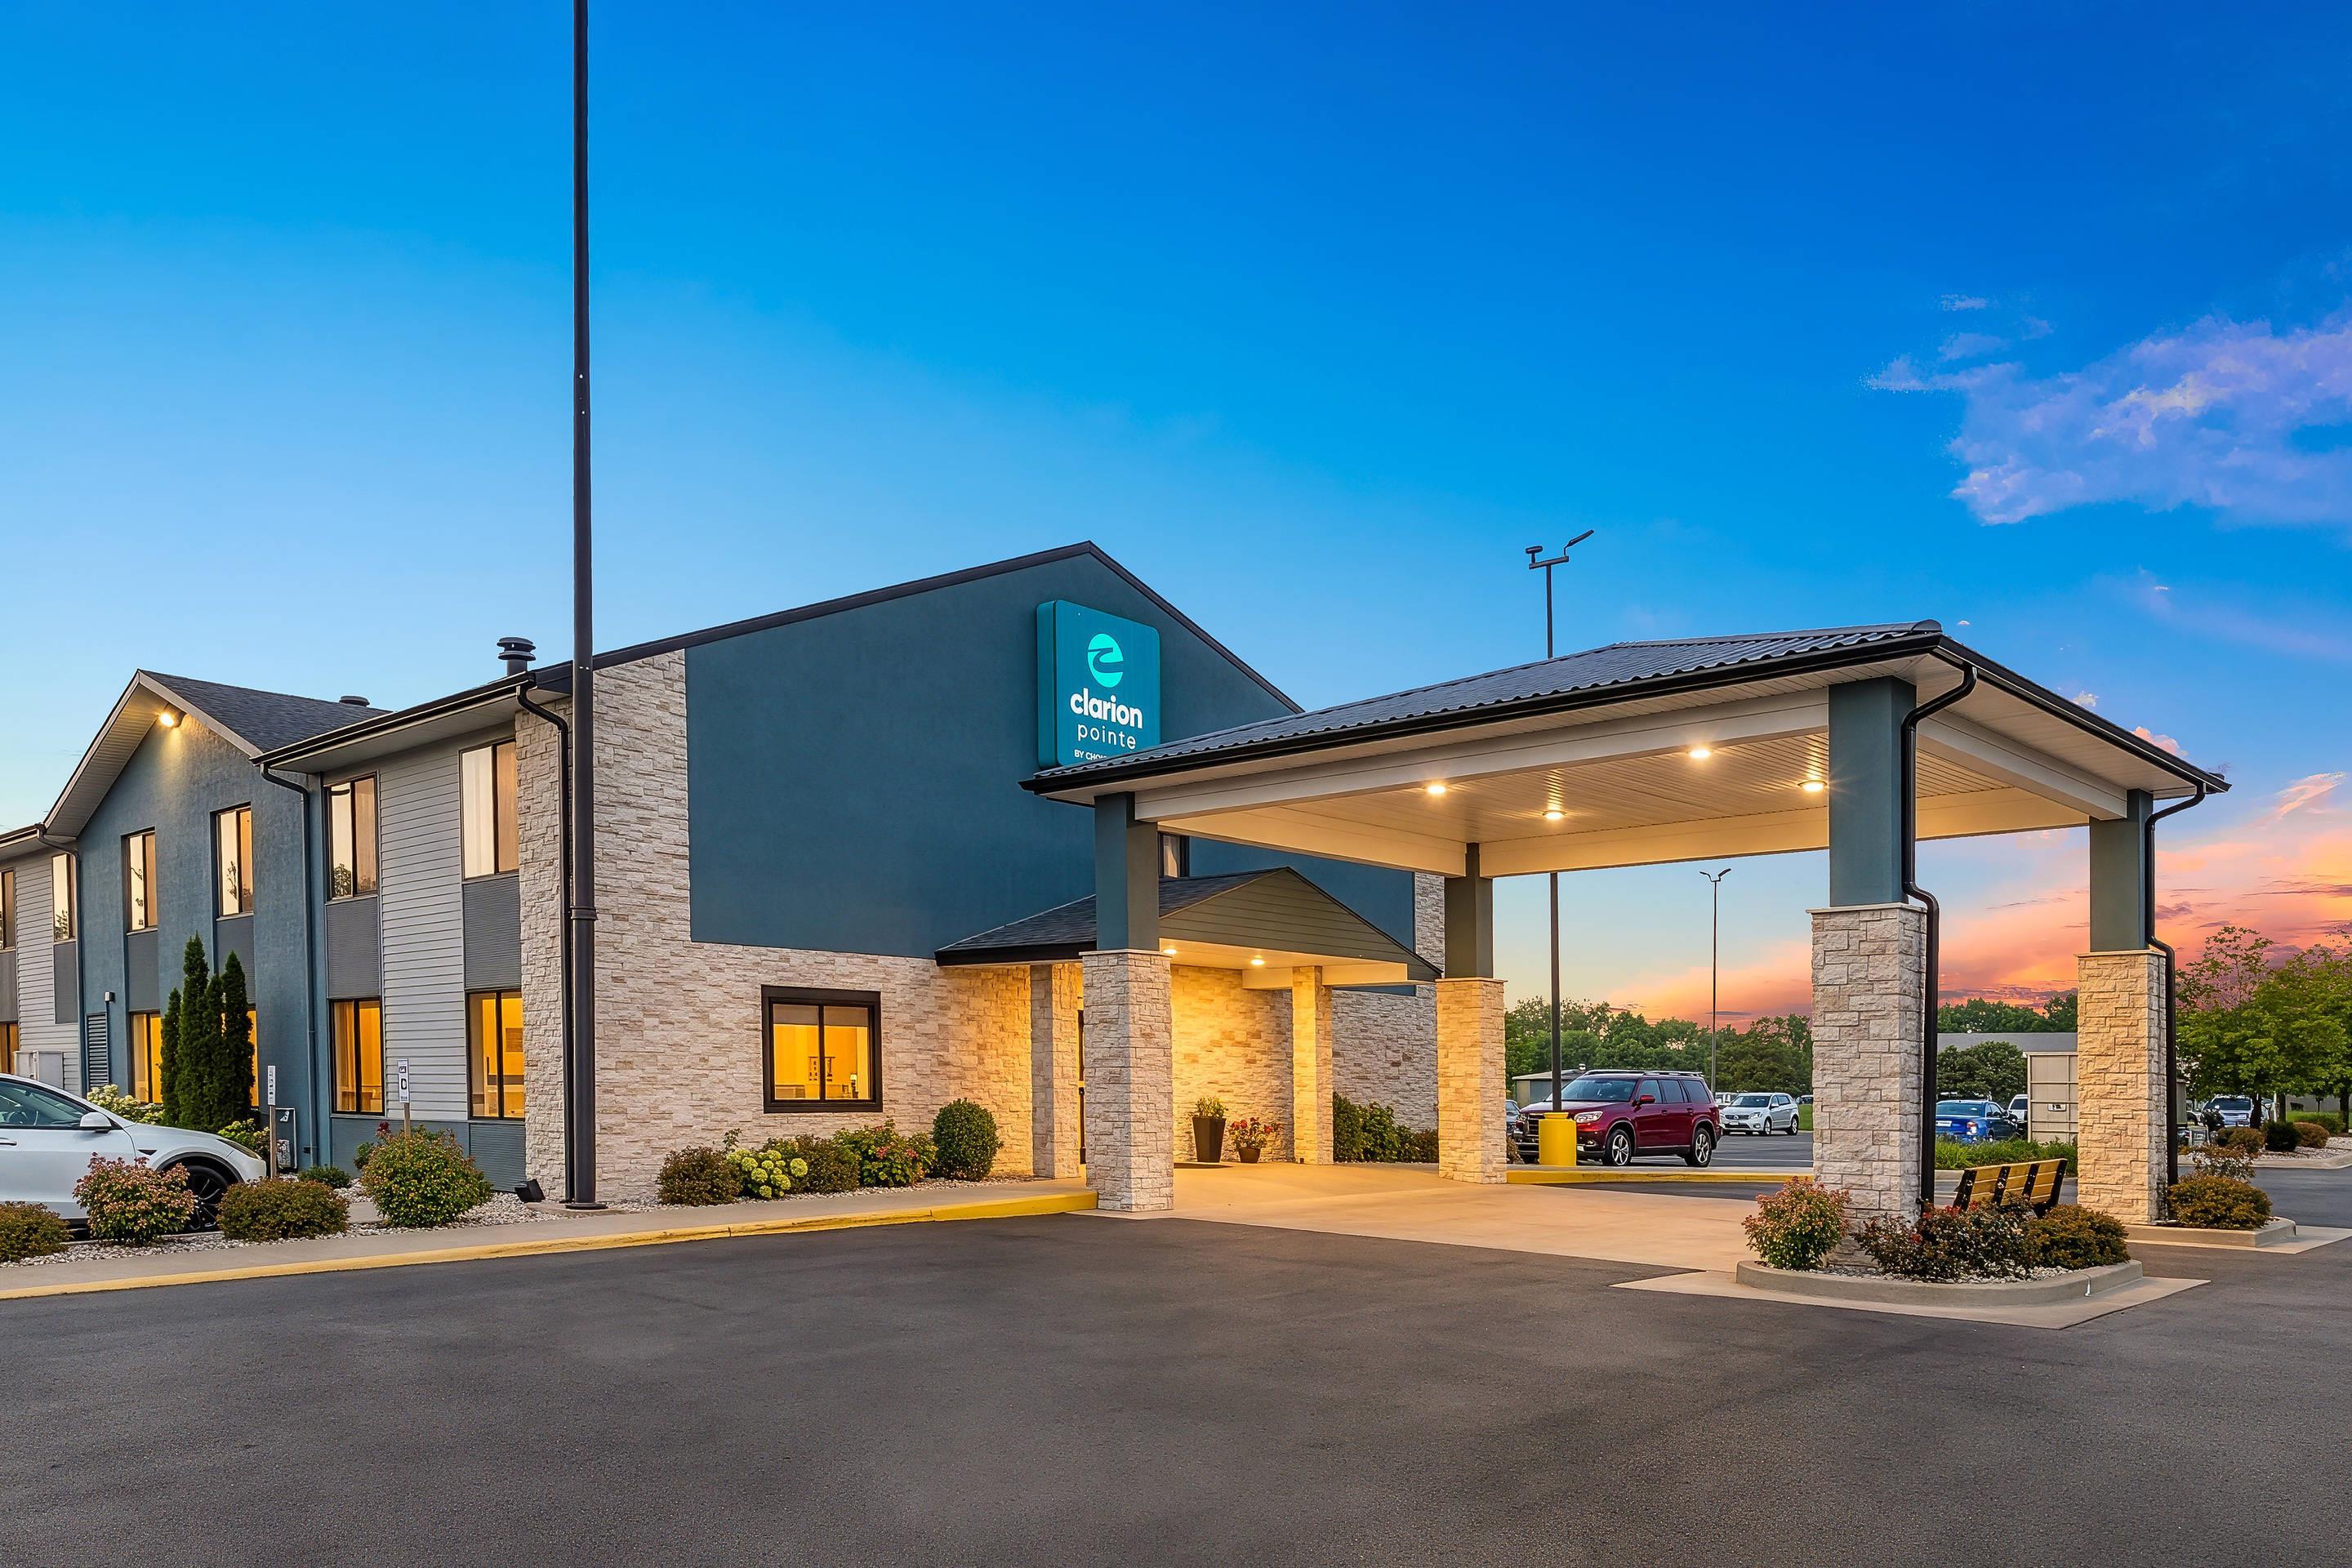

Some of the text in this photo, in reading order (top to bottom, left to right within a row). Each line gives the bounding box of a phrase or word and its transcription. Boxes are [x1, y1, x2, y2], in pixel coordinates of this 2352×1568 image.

[1070, 688, 1143, 728] clarion
[1077, 724, 1136, 750] pointe
[1074, 749, 1085, 758] BY
